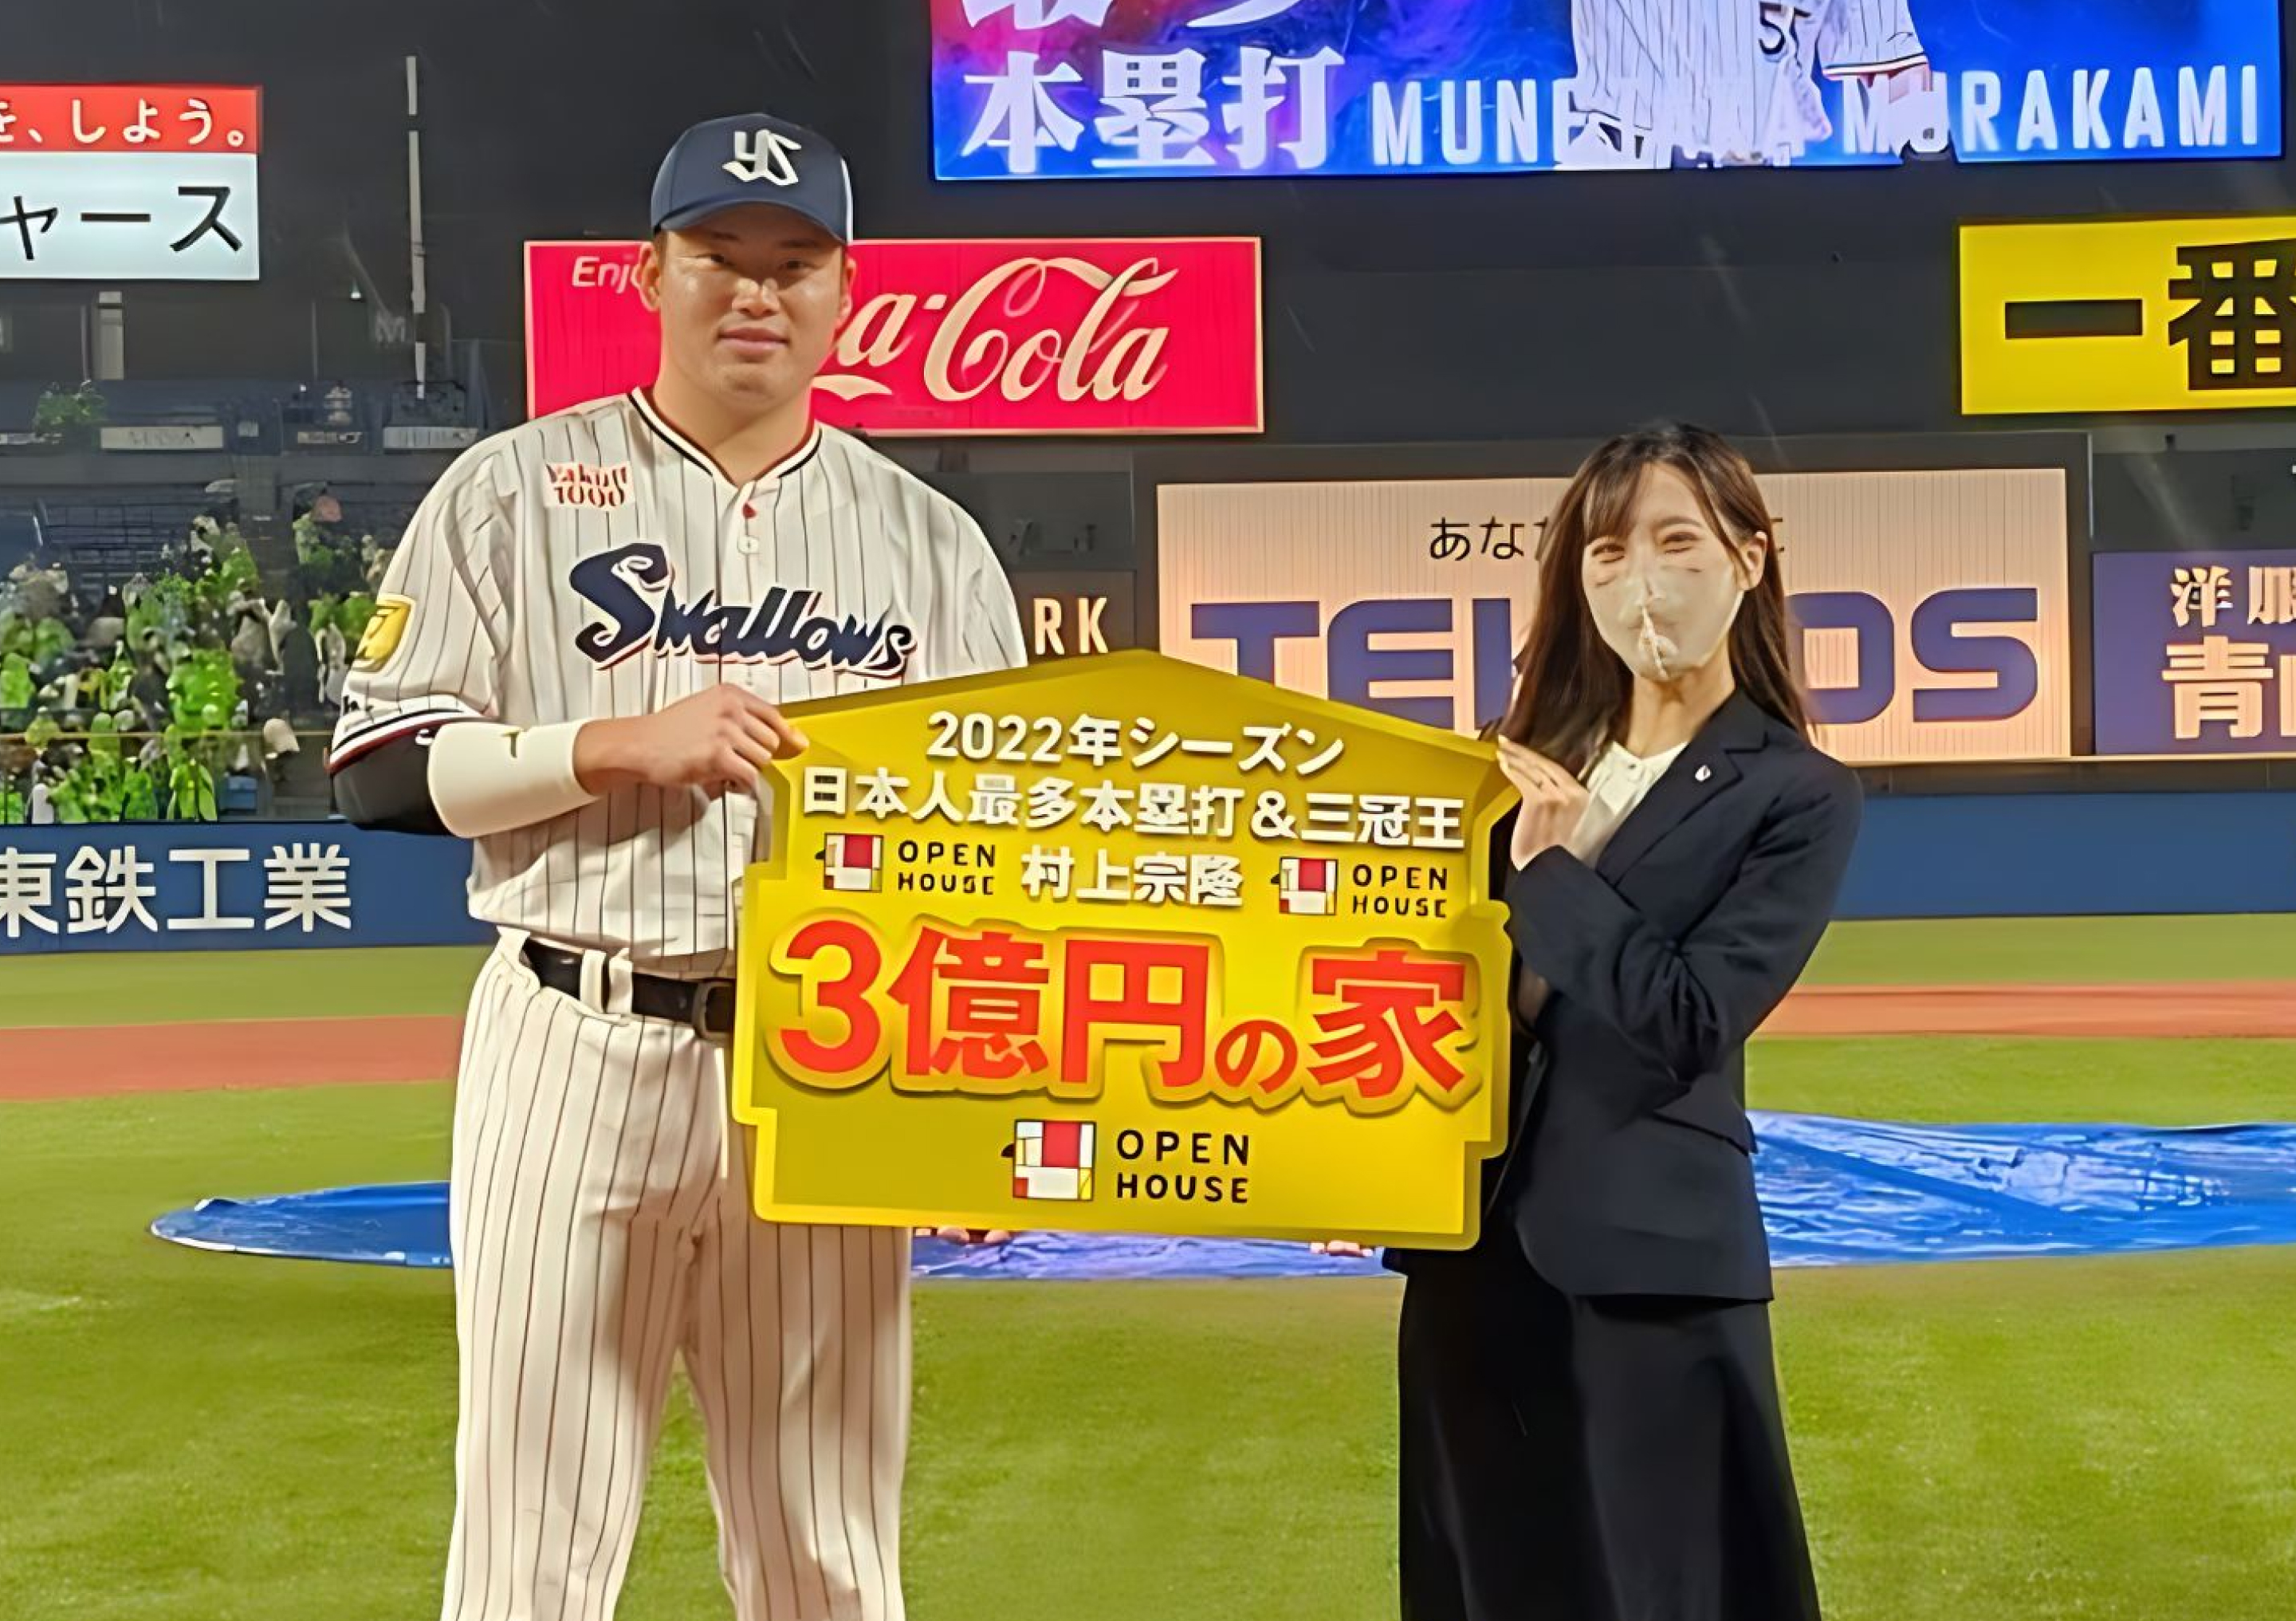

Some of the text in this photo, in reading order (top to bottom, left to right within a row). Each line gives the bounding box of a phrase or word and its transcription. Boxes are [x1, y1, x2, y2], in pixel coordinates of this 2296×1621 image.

[961, 46, 1345, 173] 本塁打
[572, 255, 640, 294] Enj
[812, 257, 1178, 402] a-Cola
[2004, 238, 2296, 391] 一番
[569, 542, 918, 677] Swallows
[1191, 587, 2038, 729] TEOS
[2161, 635, 2296, 738] 青
[926, 710, 1345, 776] 2022年シーズン
[898, 840, 995, 868] OPEN
[898, 871, 995, 895] HOUSE
[1020, 844, 1244, 907] 村上宗隆
[1352, 864, 1448, 891] OPEN
[0, 843, 352, 938] 東鉄工業
[1352, 895, 1448, 918] HOUSE
[779, 918, 1466, 1099] 3億円の家
[1115, 1128, 1249, 1167] OPEN
[1115, 1172, 1249, 1204] HOUSE
